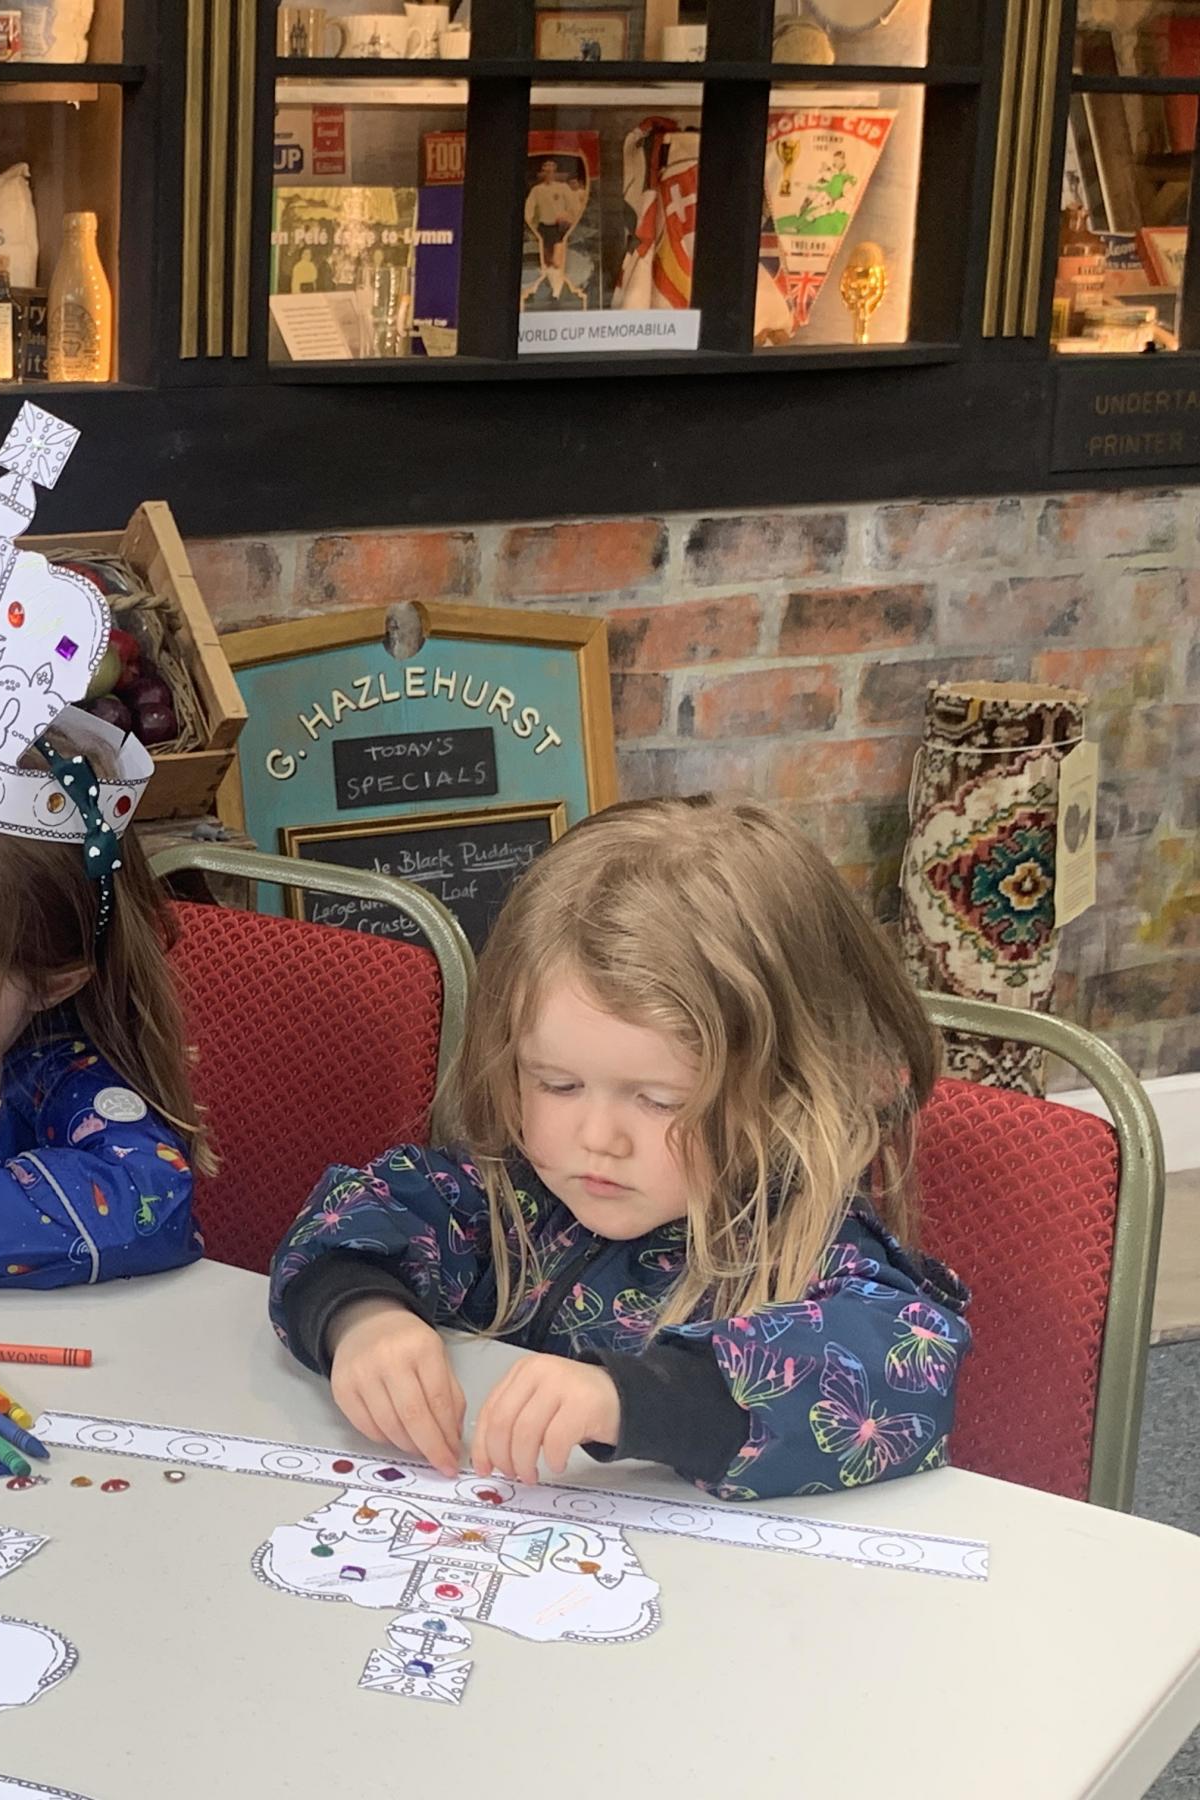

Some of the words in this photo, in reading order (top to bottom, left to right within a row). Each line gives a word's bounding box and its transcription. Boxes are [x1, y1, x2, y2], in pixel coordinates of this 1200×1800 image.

[843, 116, 881, 140] CUP
[381, 229, 401, 245] to
[403, 229, 454, 246] Lymm
[560, 326, 585, 341] CUP
[588, 322, 676, 339] MEMORABILIA
[1088, 431, 1185, 457] PRINTER
[299, 666, 563, 756] HAZLEHURST
[364, 737, 453, 761] TODAY'S
[347, 761, 487, 800] SPECIALS
[397, 849, 454, 874] Black
[459, 840, 544, 866] Pudding
[441, 880, 478, 901] Loaf
[312, 899, 357, 928] Large
